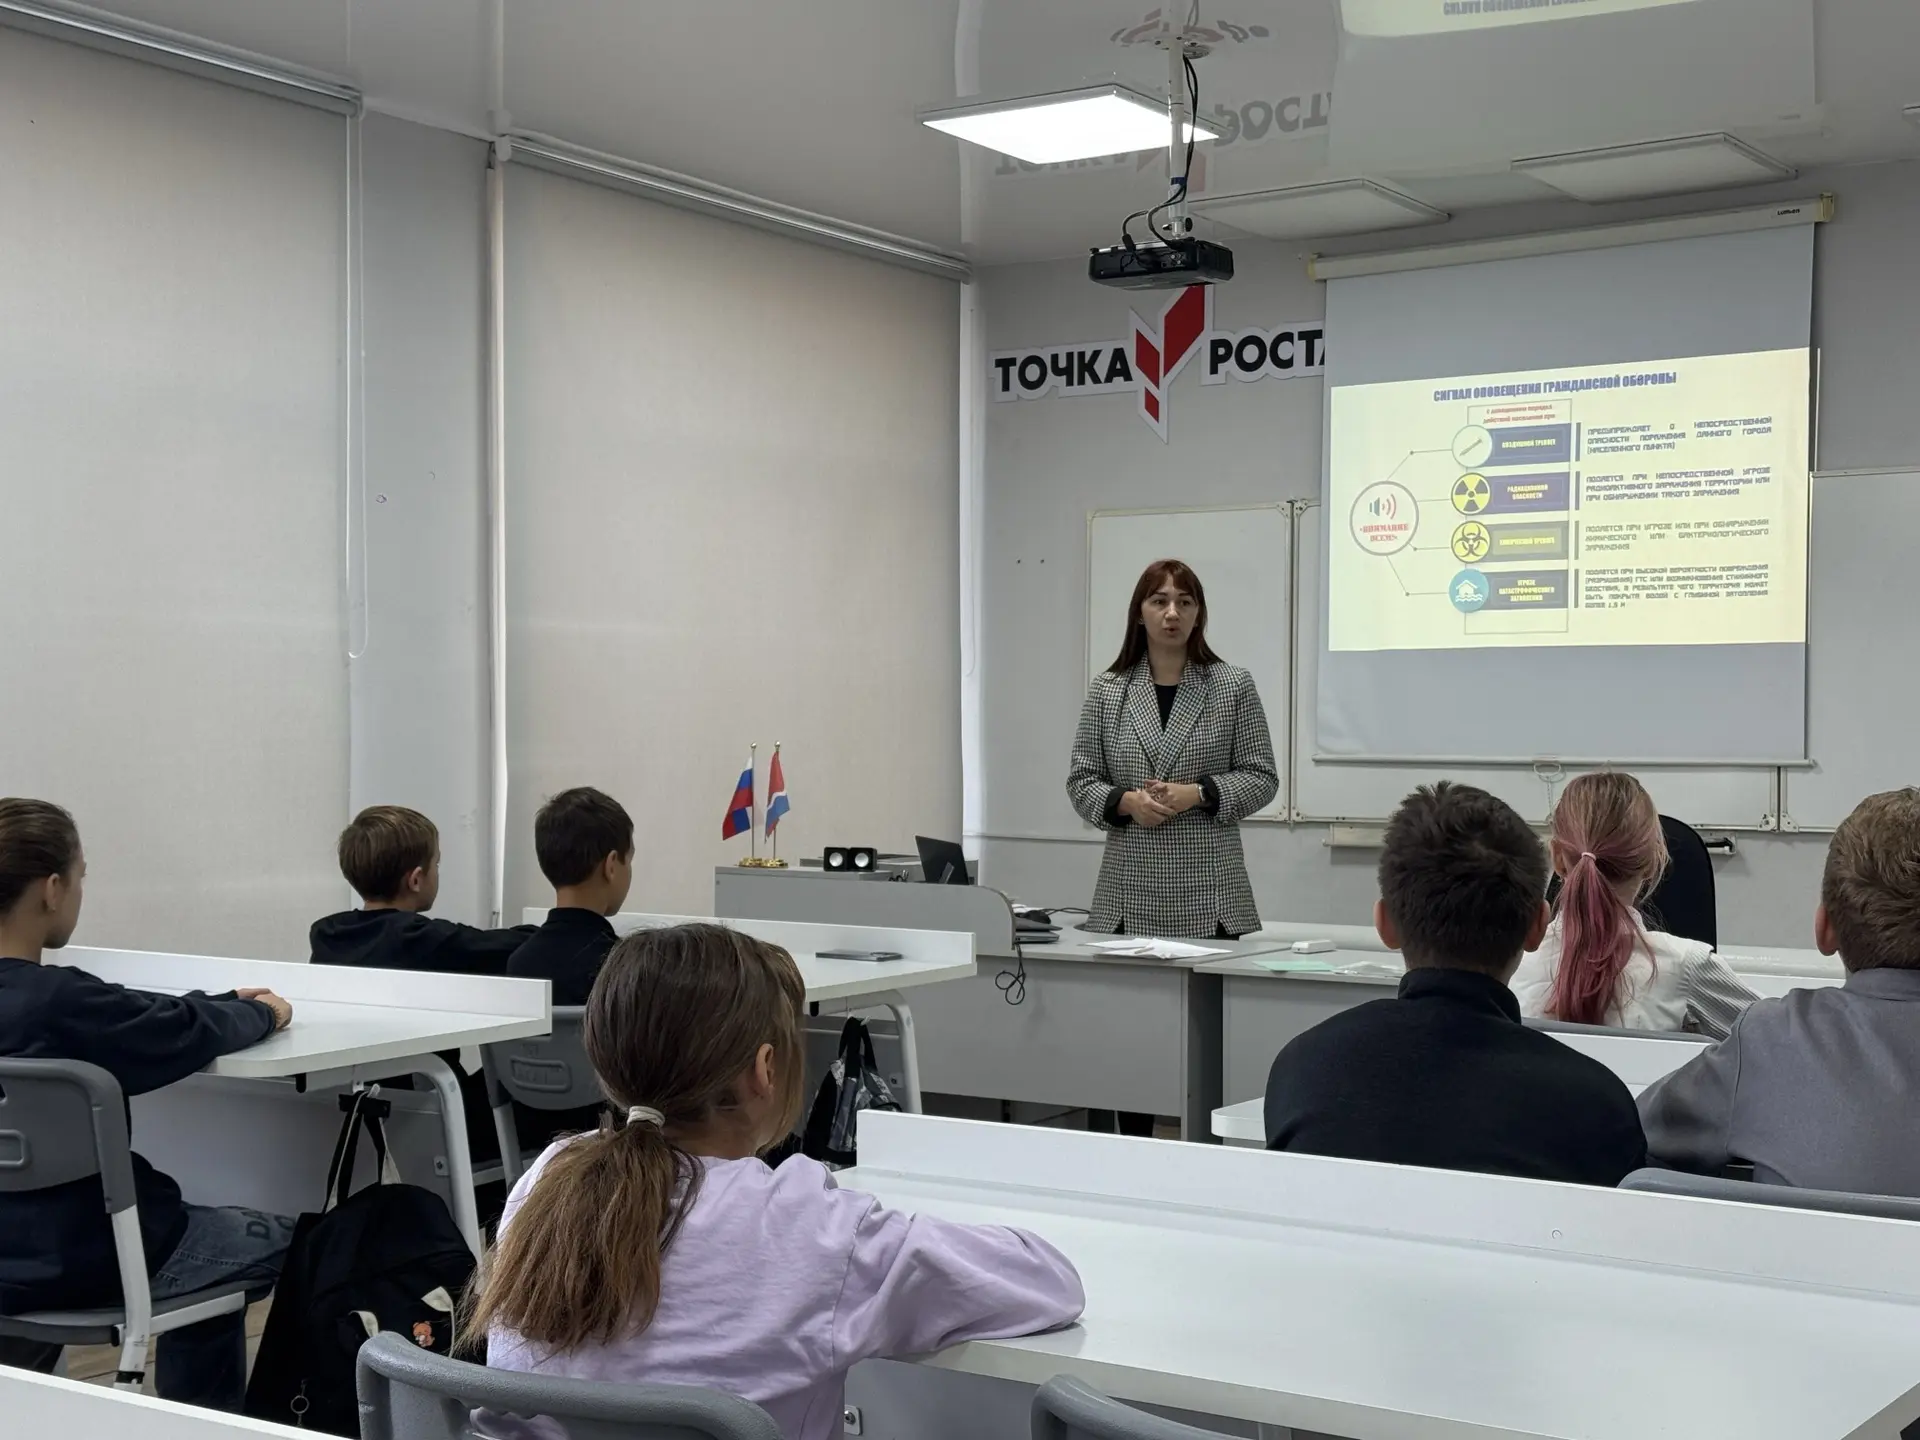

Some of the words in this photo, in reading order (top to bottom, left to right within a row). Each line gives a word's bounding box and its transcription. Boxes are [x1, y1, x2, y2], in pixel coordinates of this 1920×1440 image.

[995, 347, 1133, 392] ТОЧКА
[1434, 388, 1472, 402] СИГНАЛ
[1474, 383, 1541, 399] ОПОВЕЩЕНИЯ
[1543, 374, 1620, 393] ГРАЖДАНСКОЙ
[1623, 372, 1676, 387] ОБОРОНЫ
[1694, 416, 1772, 429] НЕПОСРЕДСТВЕННОЙ
[1588, 436, 1629, 445] ОПАСНОСТИ
[1640, 432, 1686, 441] ПОРАЖЕНИЯ
[1696, 429, 1731, 438] ДАННОГО
[1742, 426, 1771, 435] ГОРОДА
[1704, 478, 1752, 487] ТЕРРИТОРИИ
[1586, 494, 1600, 502] ПРИ
[1661, 490, 1689, 498] ТАКОГО
